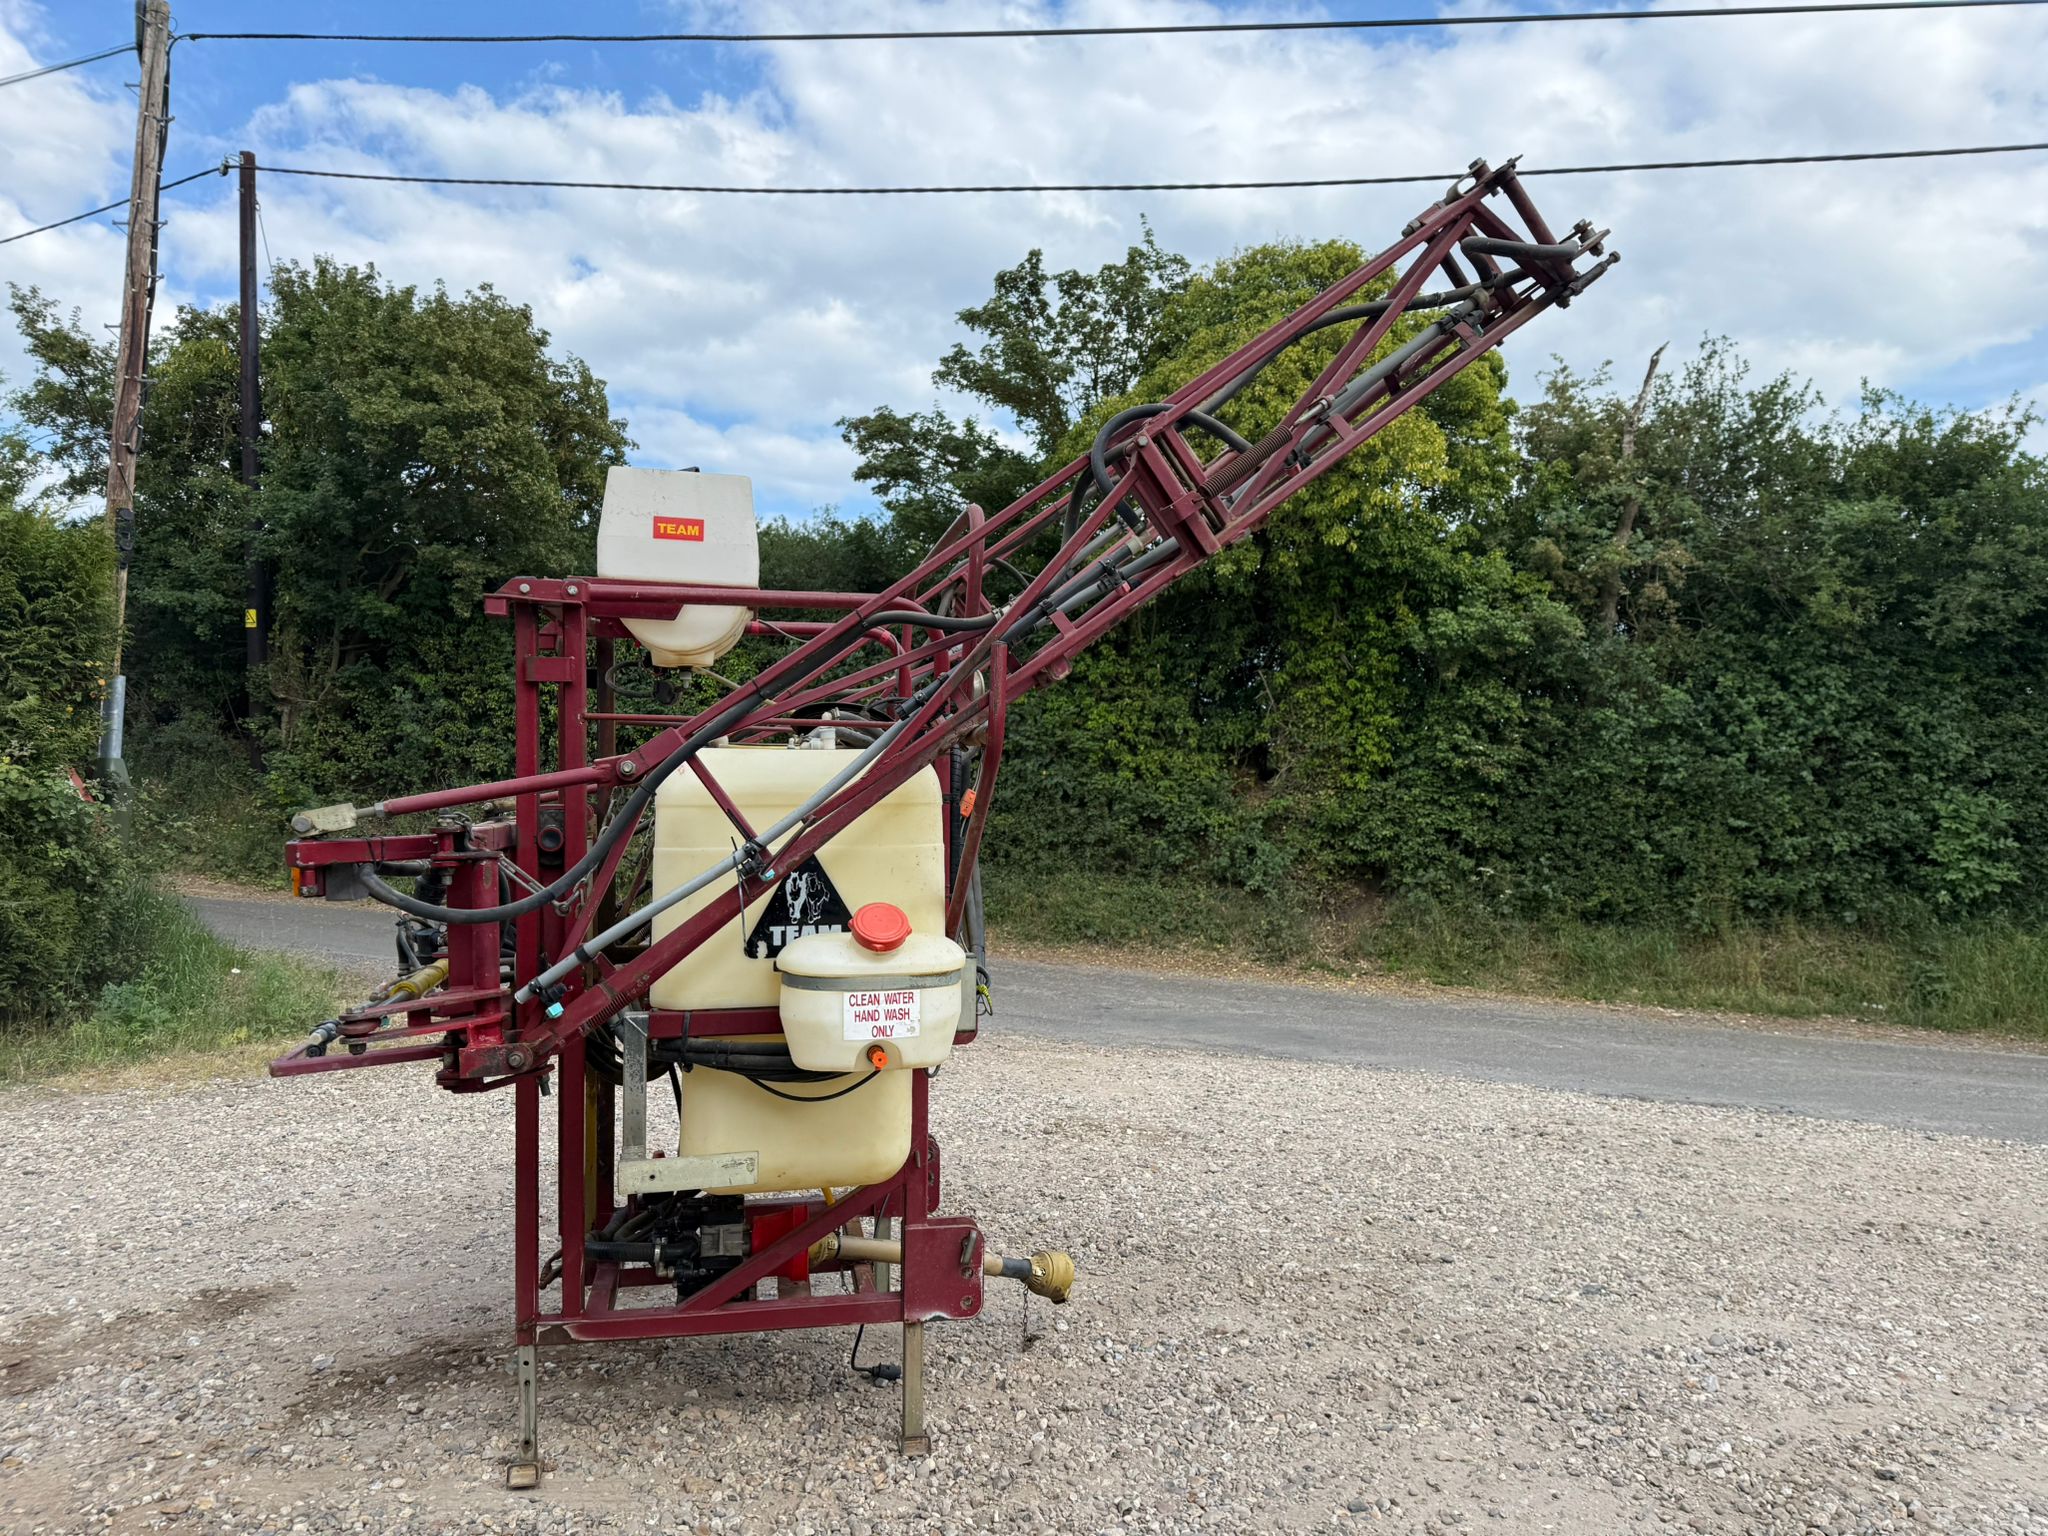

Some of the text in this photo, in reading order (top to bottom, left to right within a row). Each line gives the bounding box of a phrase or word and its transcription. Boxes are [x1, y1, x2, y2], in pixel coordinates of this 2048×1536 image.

[657, 523, 699, 536] TEAM
[849, 991, 914, 1007] CLEAN WATER
[854, 1008, 910, 1023] HAND WASH
[871, 1025, 894, 1038] ONLY
